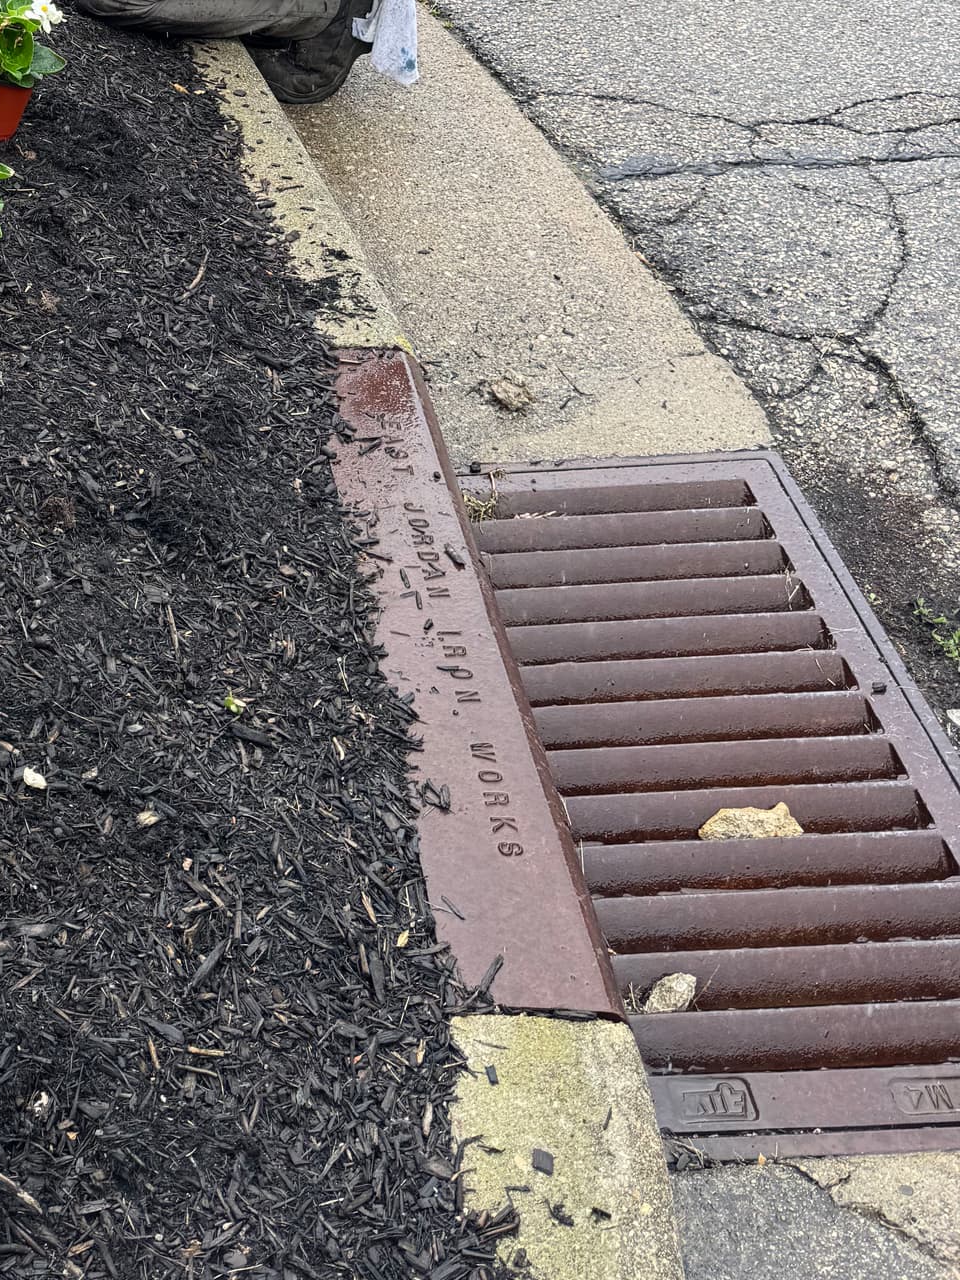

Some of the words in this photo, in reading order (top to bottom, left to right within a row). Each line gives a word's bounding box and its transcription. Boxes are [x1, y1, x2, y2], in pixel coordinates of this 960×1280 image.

[381, 415, 415, 476] EAST
[403, 502, 451, 599] JORDAN
[469, 742, 524, 857] WORKS
